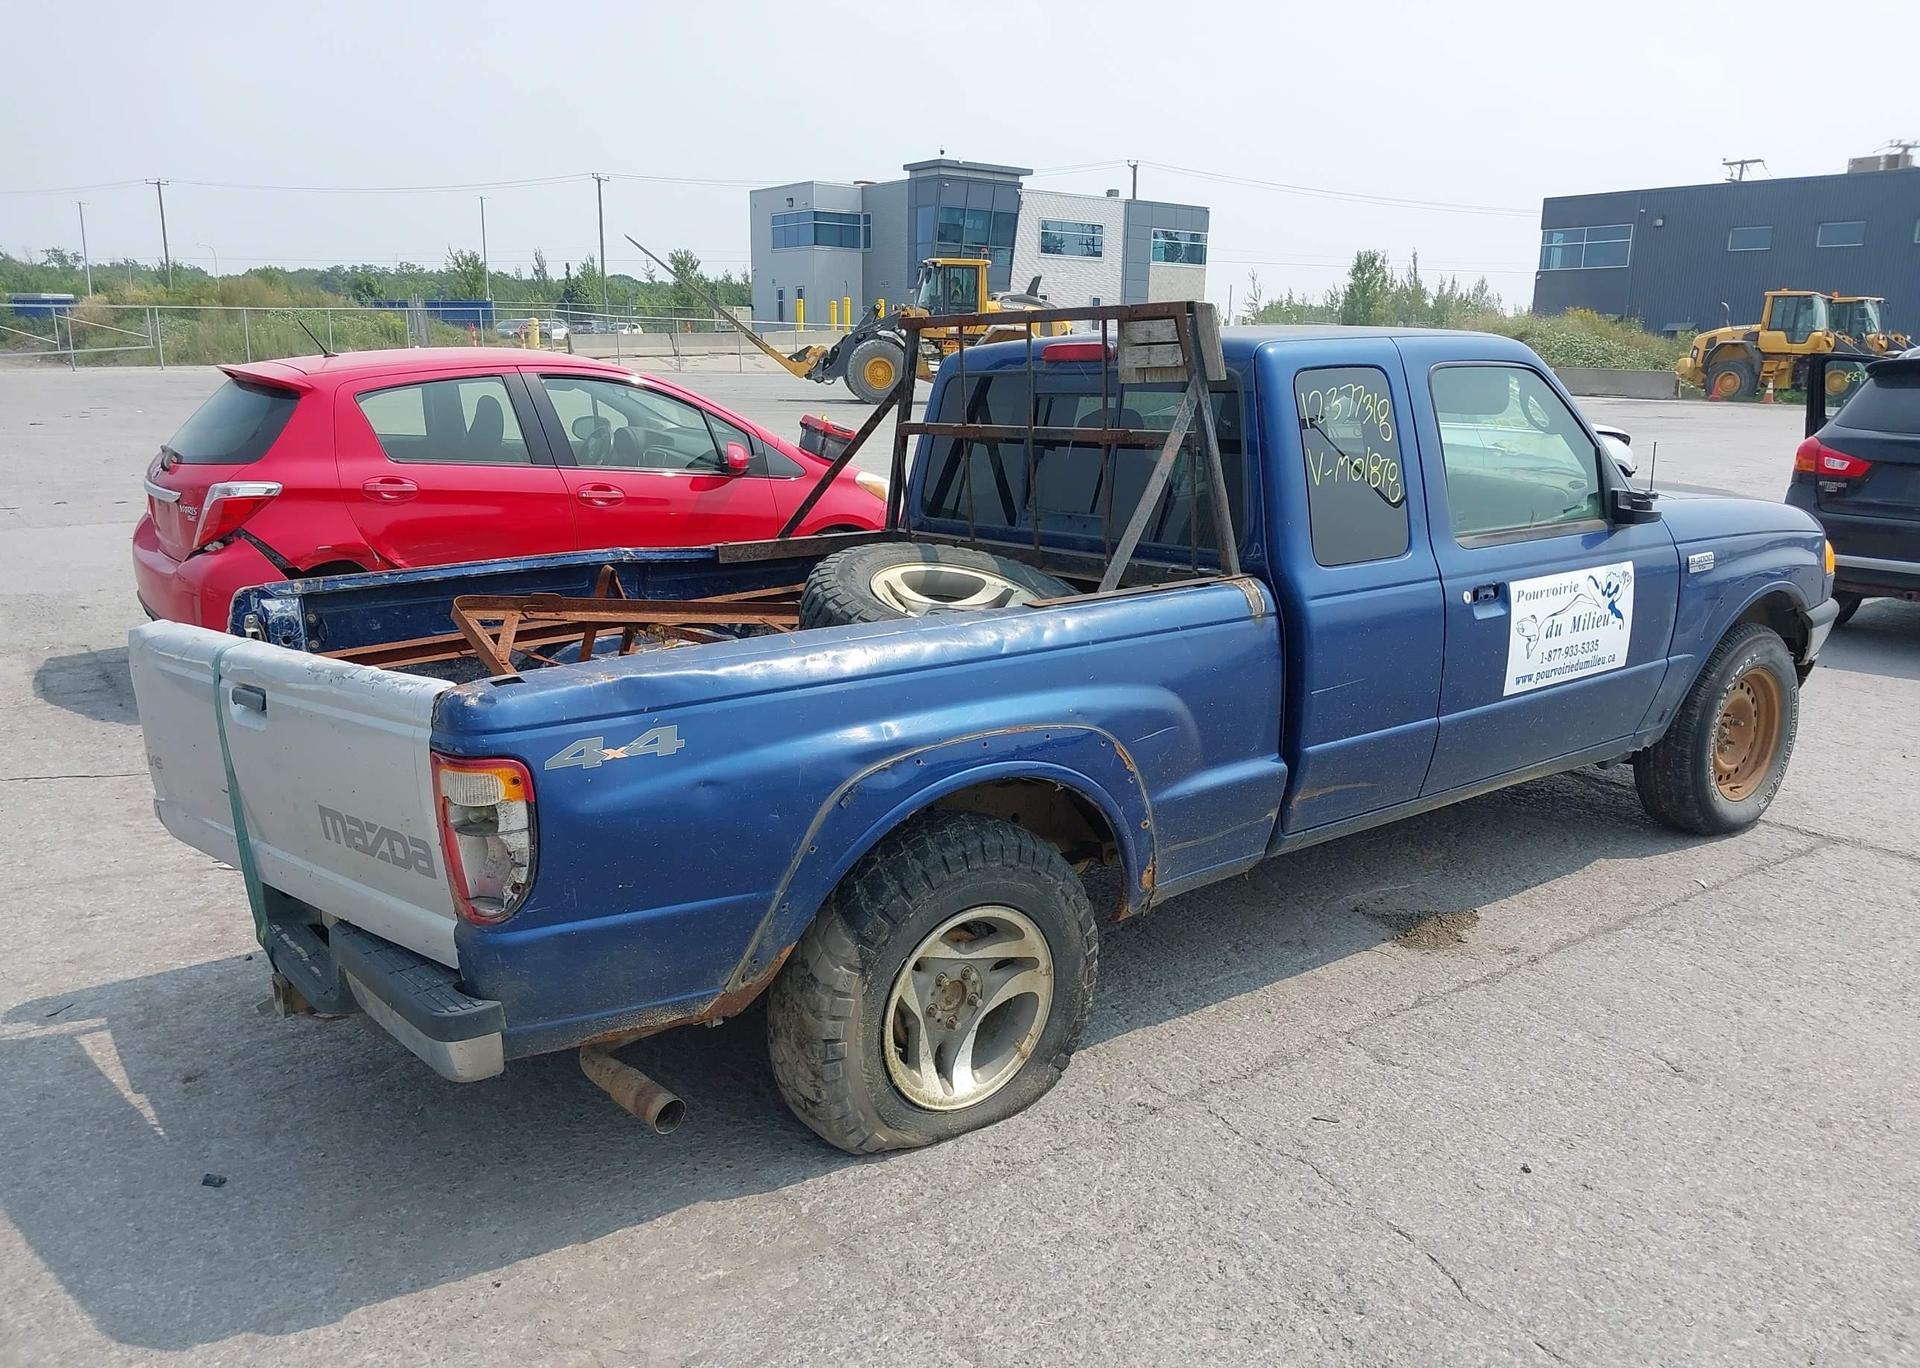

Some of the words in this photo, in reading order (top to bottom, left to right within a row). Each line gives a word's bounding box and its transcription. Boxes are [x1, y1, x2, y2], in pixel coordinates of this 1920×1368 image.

[1302, 384, 1393, 441] 12377318
[1516, 583, 1579, 603] Pourvoirie
[1545, 618, 1562, 640] du
[1570, 611, 1610, 634] Milieu
[1540, 639, 1600, 664] 1-877-933-5335
[1514, 653, 1616, 686] www.pourvoiriedumilieu.ca
